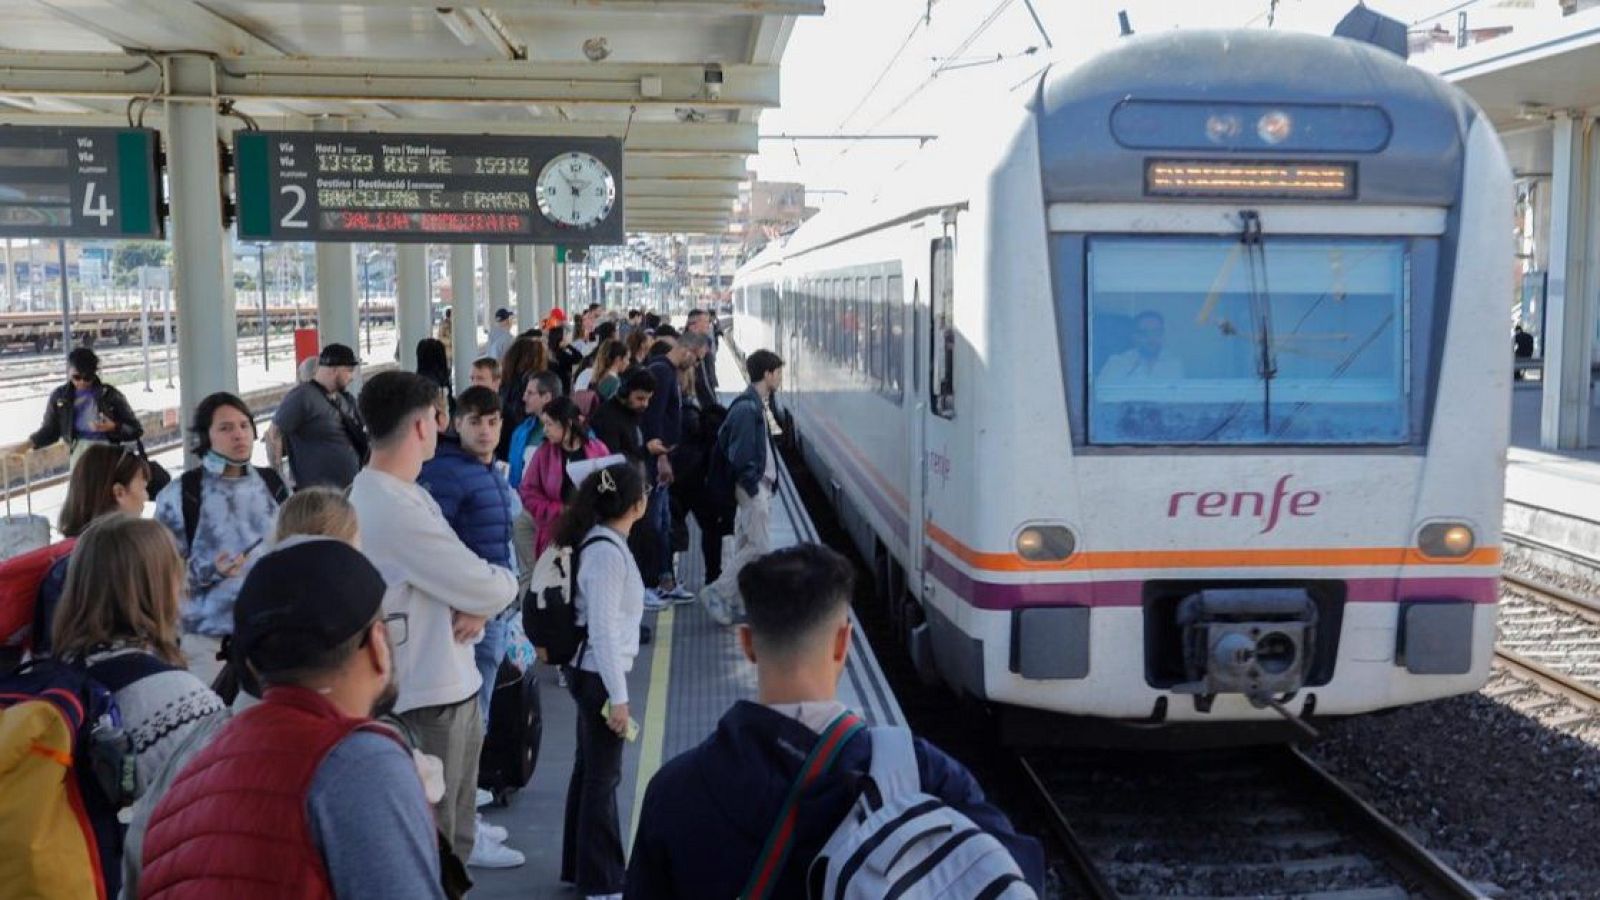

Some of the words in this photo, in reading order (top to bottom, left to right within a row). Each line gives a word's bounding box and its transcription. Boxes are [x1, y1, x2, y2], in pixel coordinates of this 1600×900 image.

[315, 144, 337, 154] Hora
[82, 181, 114, 227] 4
[317, 178, 351, 188] Destino
[280, 184, 308, 227] 2
[1167, 473, 1321, 534] renfe
